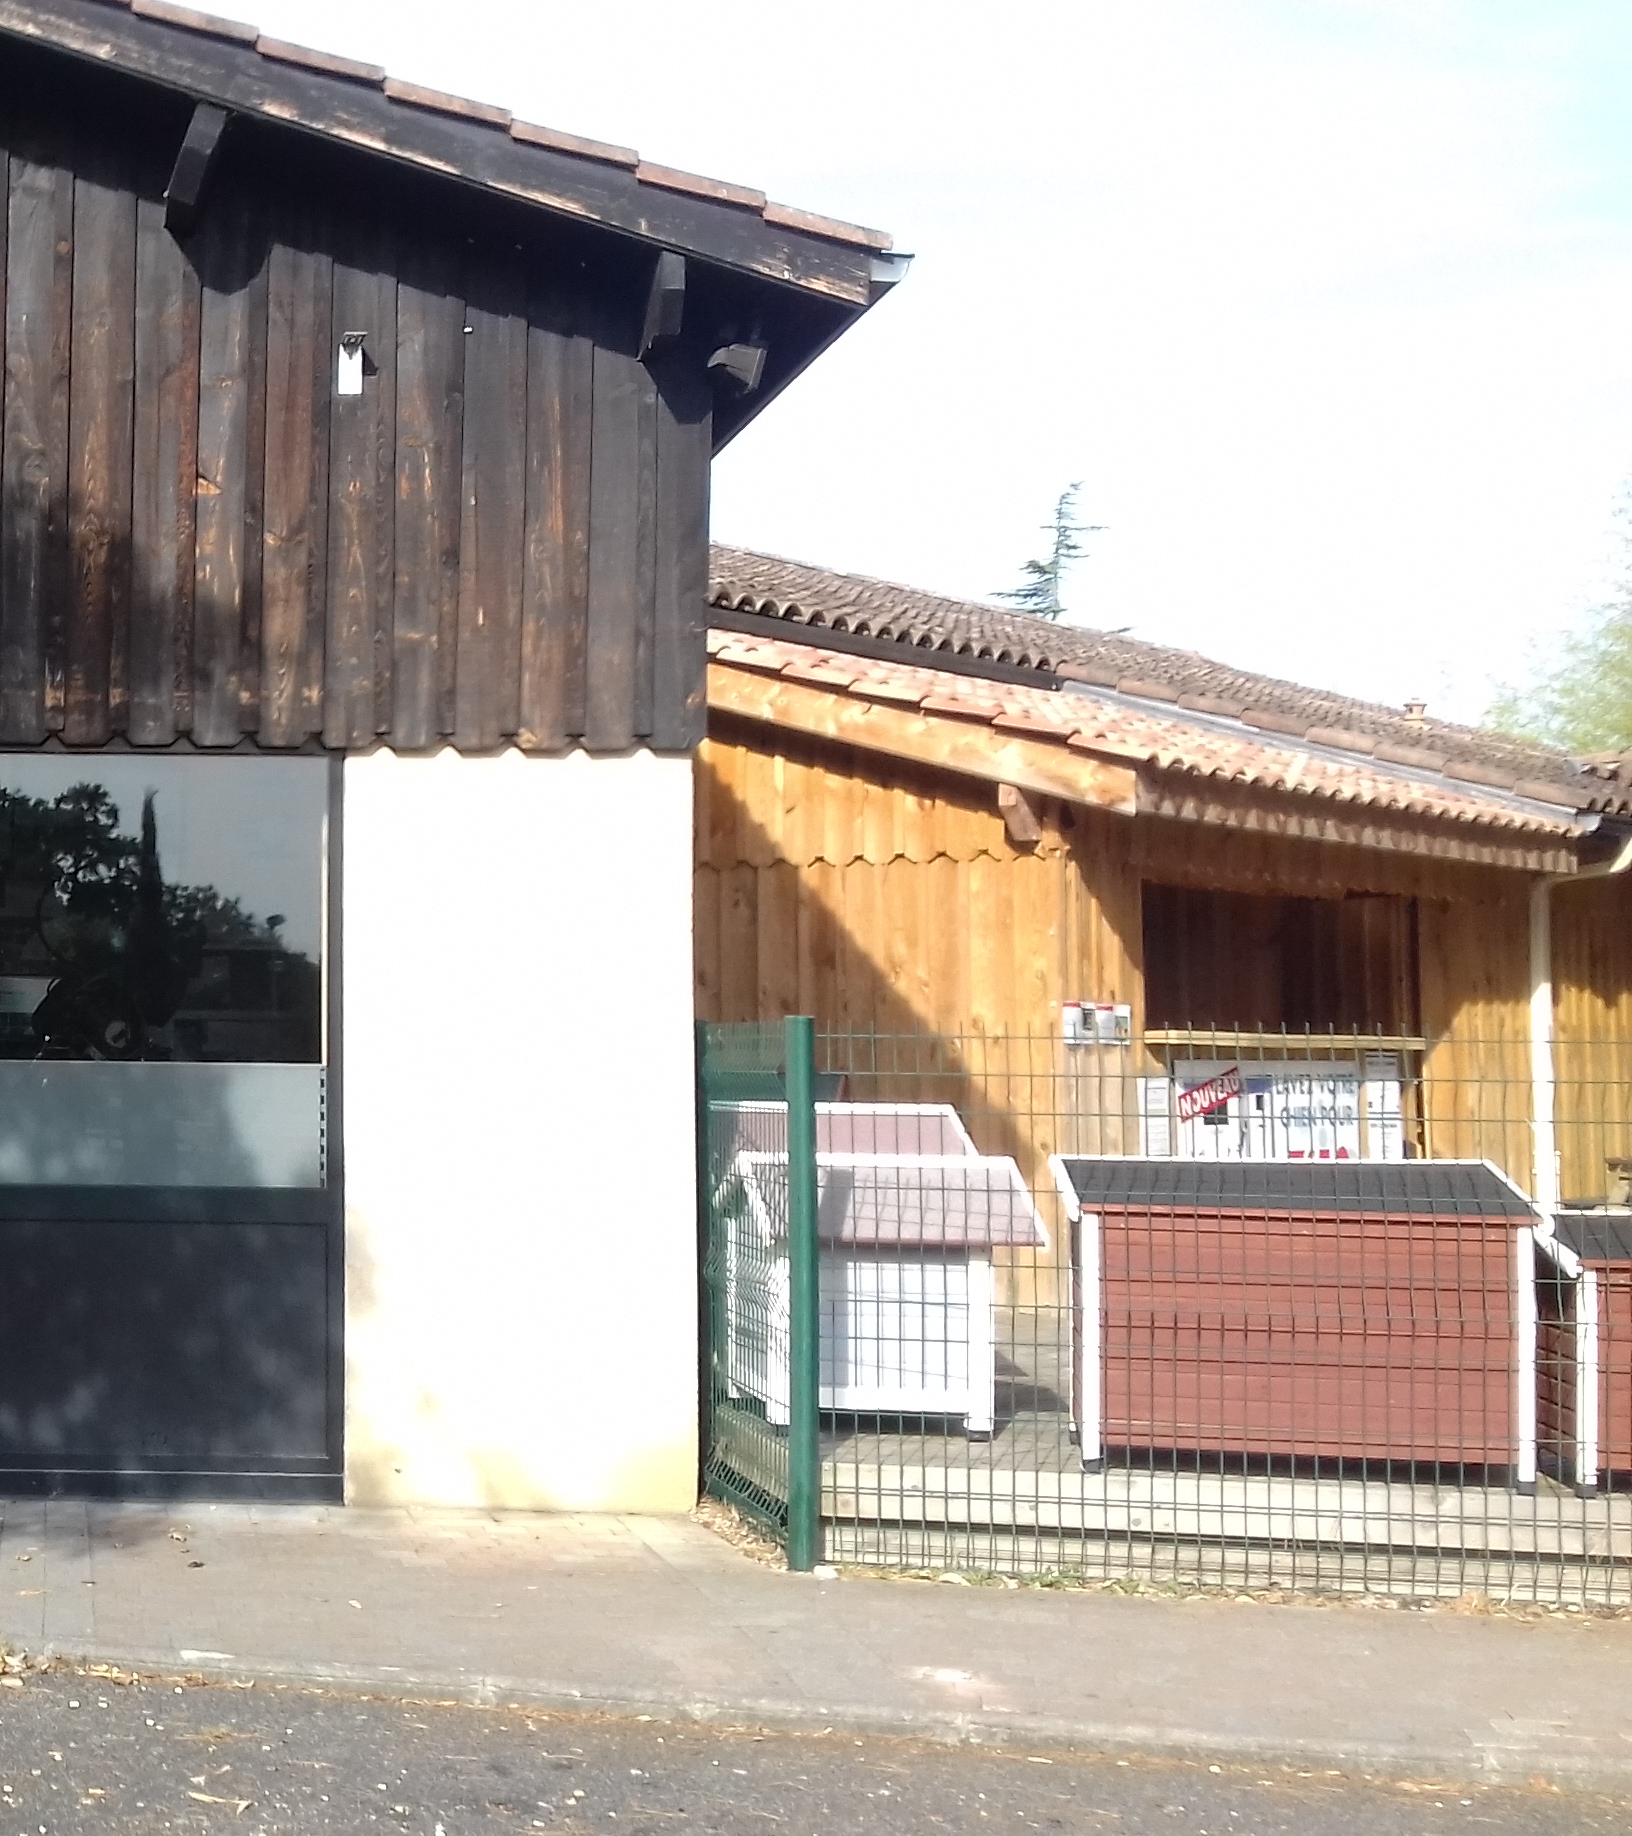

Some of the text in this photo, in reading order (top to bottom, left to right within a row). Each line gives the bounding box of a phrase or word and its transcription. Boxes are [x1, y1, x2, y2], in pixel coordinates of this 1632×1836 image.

[1179, 1074, 1241, 1117] NOUVEAU
[1275, 1073, 1312, 1095] LAVEZ
[1280, 1105, 1317, 1128] CHIEN
